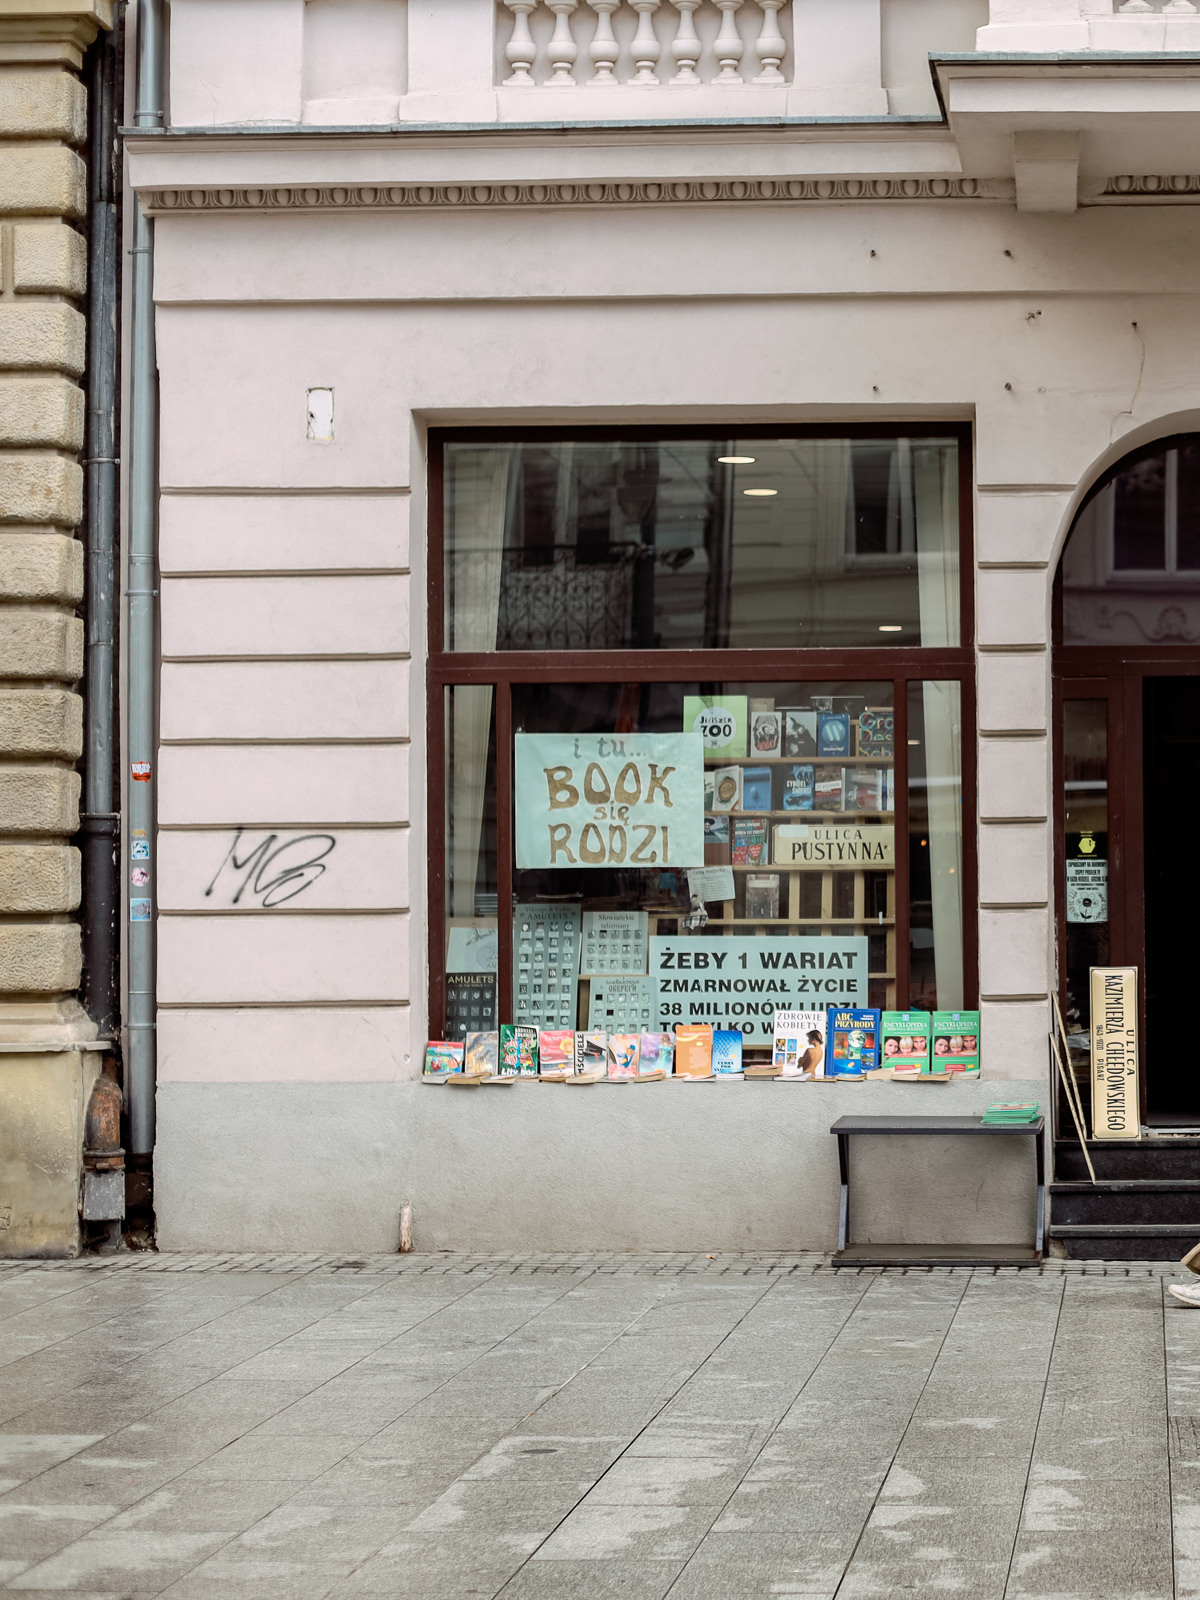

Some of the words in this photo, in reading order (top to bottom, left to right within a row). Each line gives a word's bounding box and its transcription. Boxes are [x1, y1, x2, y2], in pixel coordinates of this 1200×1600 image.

[701, 724, 732, 737] ZOO
[543, 761, 677, 812] BOOK
[593, 801, 630, 826] się
[814, 829, 863, 840] ULICA
[548, 822, 669, 865] RODZI
[792, 842, 885, 861] PUSTYNNA
[659, 947, 728, 969] ŻEBY
[738, 952, 748, 969] 1
[759, 952, 858, 969] WARIAT
[447, 975, 494, 984] AMULETS
[659, 979, 791, 993] ZMARNOWAŁ
[797, 975, 858, 993] ŻYCIE
[659, 1002, 683, 1016] 38
[689, 999, 793, 1016] MILIONÓW
[1104, 975, 1124, 1035] KAZIMIERZA
[776, 1021, 819, 1029] KOBIETY
[777, 1012, 822, 1021] ZDROWIE
[834, 1020, 876, 1029] PRZYRODY
[835, 1012, 854, 1021] ABC
[691, 1021, 755, 1034] YLKO
[1126, 1029, 1135, 1076] ULICA
